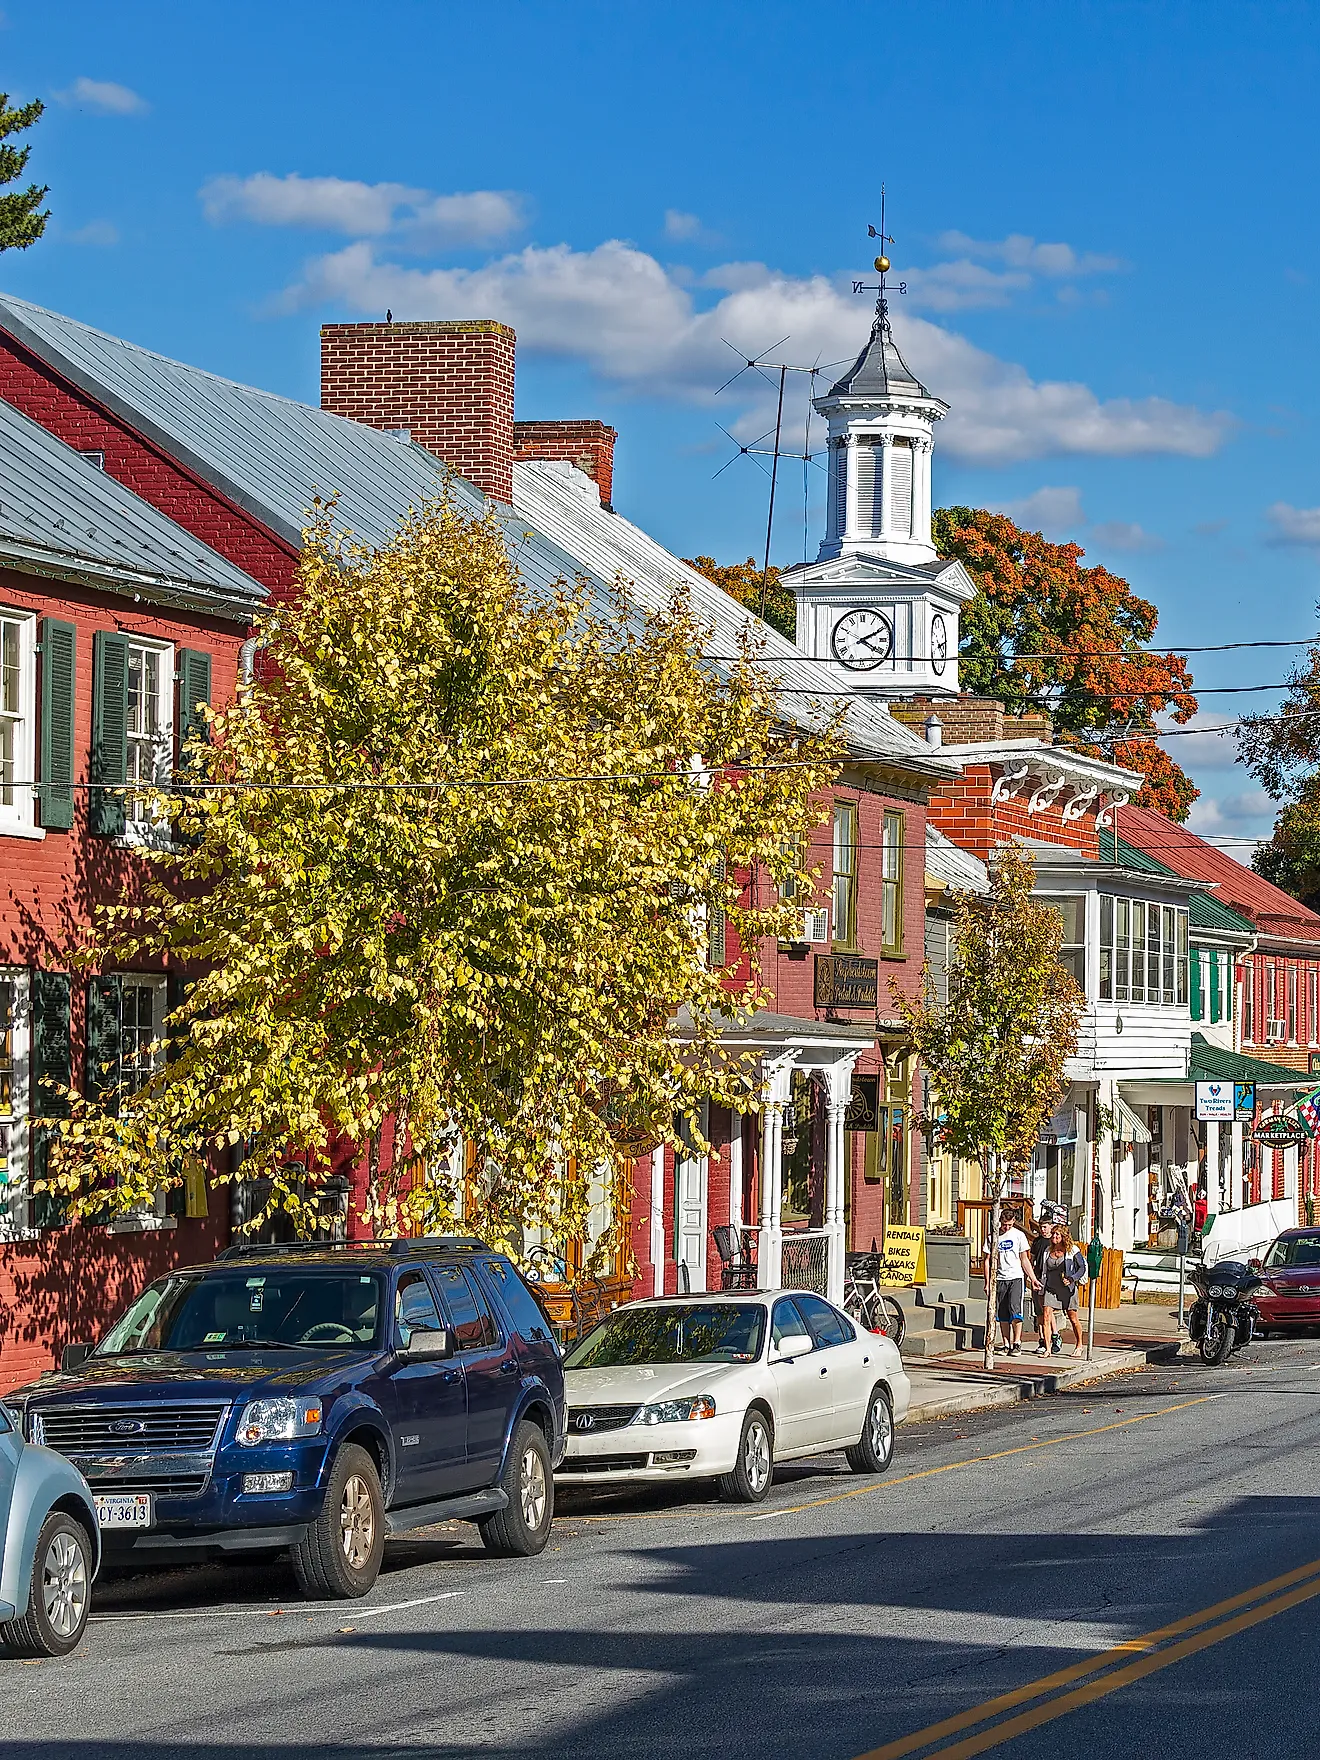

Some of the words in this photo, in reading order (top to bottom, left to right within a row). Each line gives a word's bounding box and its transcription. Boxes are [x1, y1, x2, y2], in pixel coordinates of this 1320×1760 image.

[886, 1230, 921, 1242] RENTALS
[887, 1247, 911, 1257] BIKES
[882, 1259, 916, 1270] KAYAKS
[879, 1270, 914, 1282] CANOES
